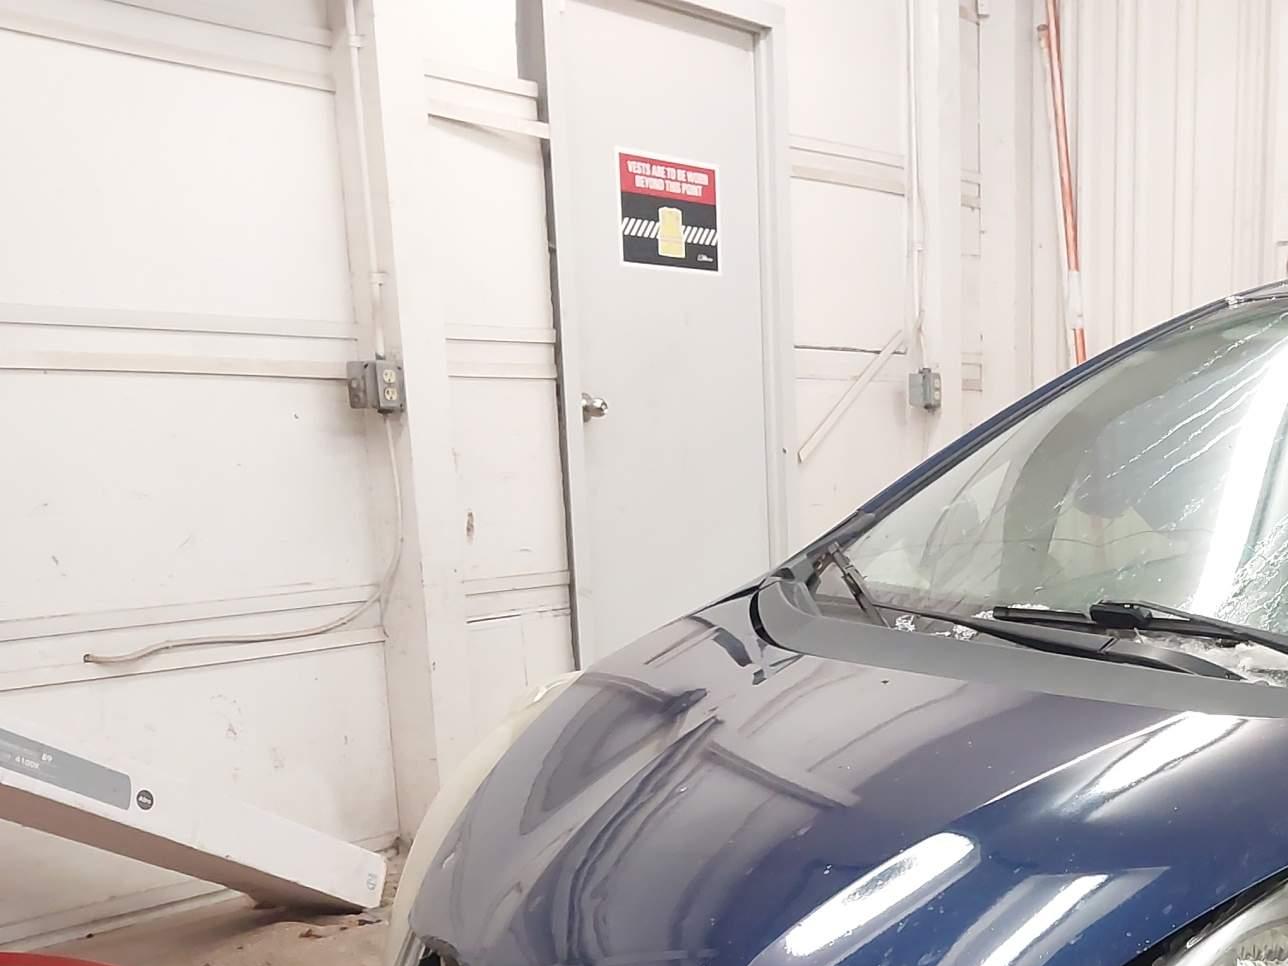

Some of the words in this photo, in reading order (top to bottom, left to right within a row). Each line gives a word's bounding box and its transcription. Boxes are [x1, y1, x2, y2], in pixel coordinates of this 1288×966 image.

[627, 160, 651, 176] VESTS
[651, 165, 666, 178] ARE
[667, 167, 676, 180] TO
[677, 169, 687, 182] BE
[635, 175, 665, 191] BEYOND
[665, 180, 682, 194] THIS
[682, 184, 703, 197] POINT
